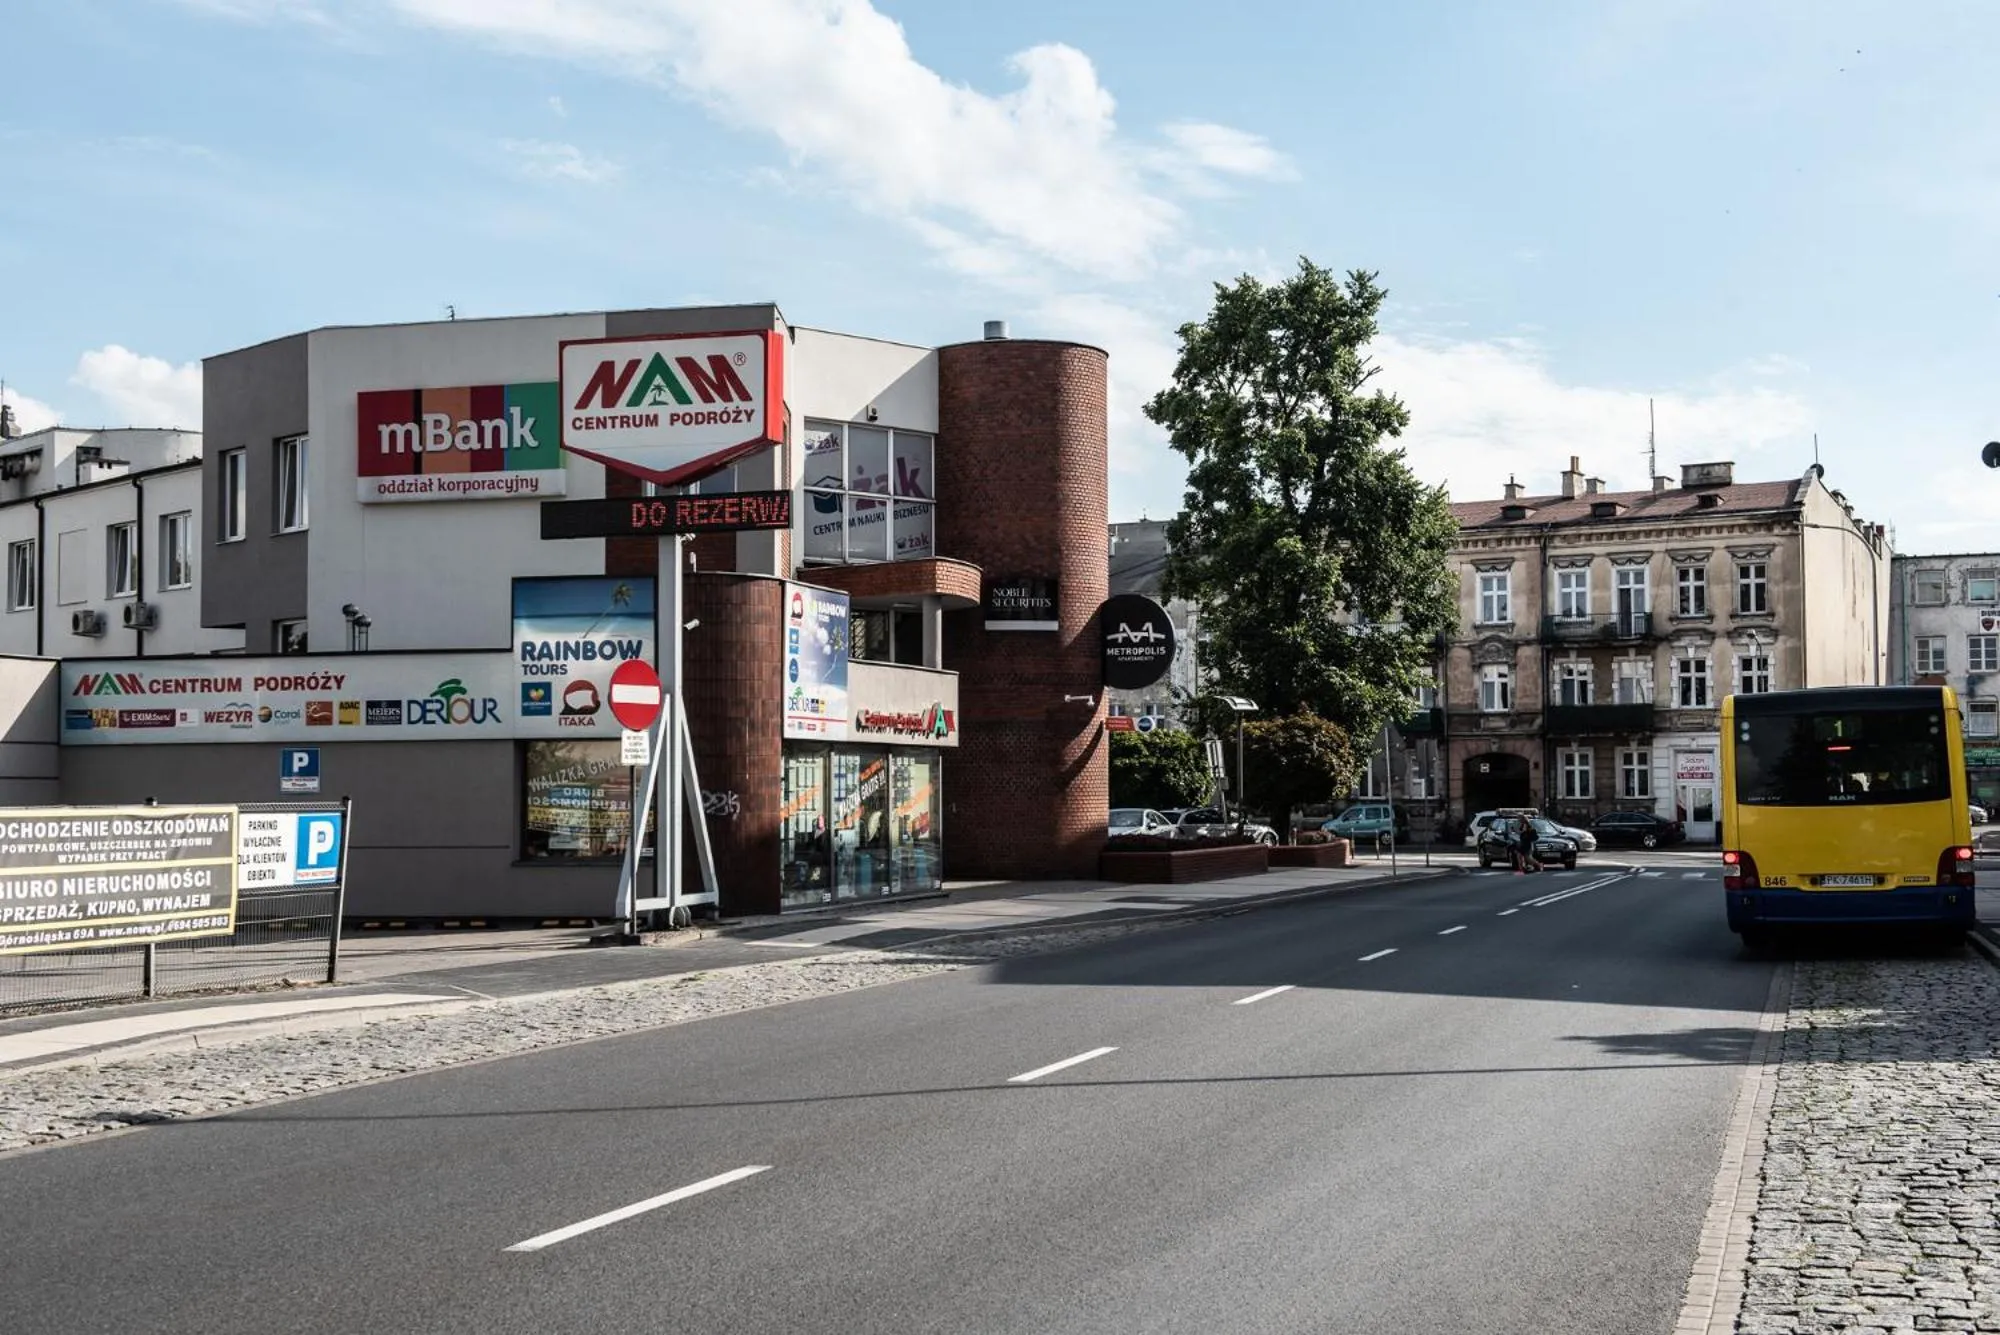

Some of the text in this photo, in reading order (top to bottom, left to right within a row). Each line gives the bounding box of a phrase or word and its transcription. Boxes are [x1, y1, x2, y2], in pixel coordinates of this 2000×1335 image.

[574, 352, 753, 410] NAM
[572, 406, 756, 430] CENTRUM PODRÓŻY
[378, 406, 539, 454] mBank
[378, 475, 539, 494] oddział korporacyjny
[631, 502, 667, 528] DO
[813, 517, 857, 536] CENTRM
[993, 587, 1028, 597] NOBLE
[992, 597, 1052, 608] SECURITIES
[521, 638, 643, 662] RAINBOW
[1107, 646, 1166, 656] METROPOLIS
[522, 663, 568, 676] TOURS
[72, 671, 346, 696] NAM CENTRUM PODRÓŻY
[274, 708, 301, 719] Coral
[339, 701, 360, 710] ADAC
[204, 710, 253, 723] WEZYR
[558, 716, 597, 727] ITAKA
[1834, 720, 1843, 737] 1
[292, 752, 309, 773] P
[528, 766, 585, 793] WALIZKA
[112, 814, 229, 835] ODSZKODOWAŃ
[248, 820, 277, 830] PARKING
[154, 839, 167, 849] NA
[307, 820, 334, 865] P
[110, 851, 134, 861] PRZY
[136, 850, 167, 860] PRACY
[63, 868, 211, 896] NIERUCHOMOŚCI
[247, 869, 276, 880] OBIEKTU
[1765, 876, 1787, 887] 846
[0, 893, 211, 922] PRZEDAŻ, KUPNO, WYNAJEM
[73, 928, 94, 940] 69A
